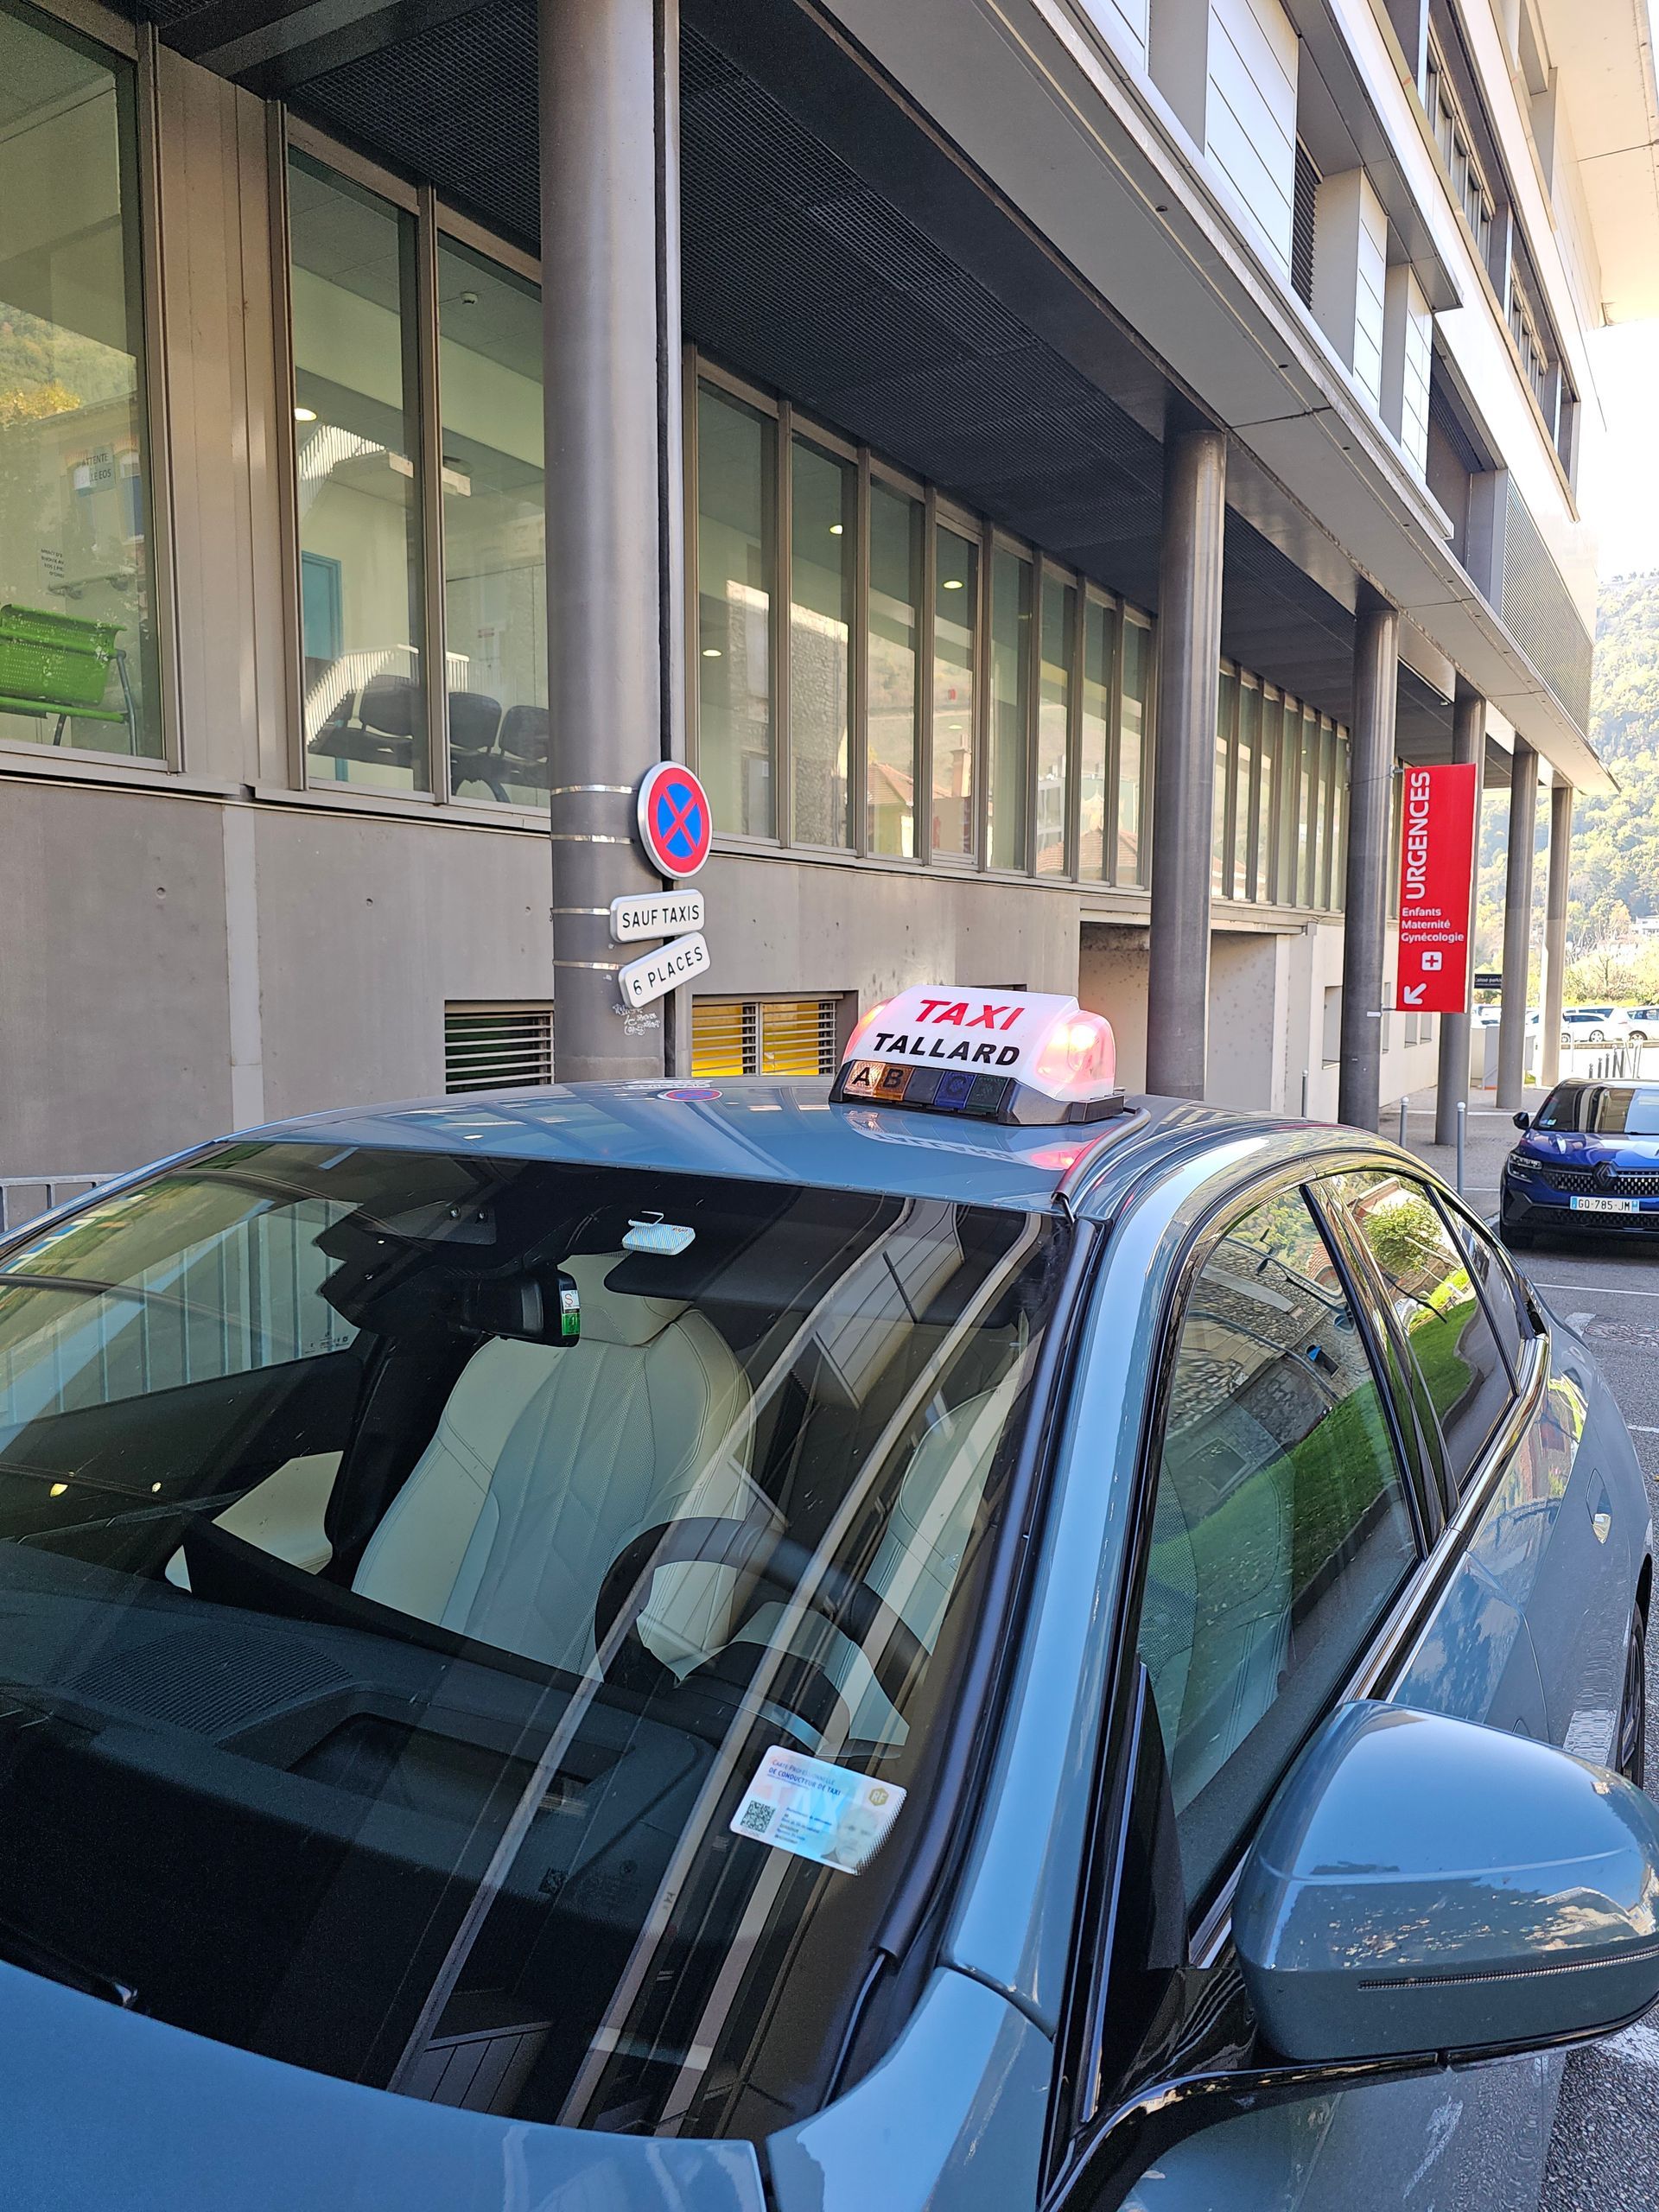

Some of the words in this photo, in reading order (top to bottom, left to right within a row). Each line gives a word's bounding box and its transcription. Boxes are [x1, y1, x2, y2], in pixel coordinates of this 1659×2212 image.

[82, 453, 109, 467] ATTENTE
[99, 468, 111, 480] EOS
[1406, 772, 1431, 899] URGENCES
[622, 909, 658, 929] SAUF
[662, 905, 700, 925] TAXIS
[1402, 906, 1442, 917] Enfants
[1401, 919, 1451, 930] Maternité
[1401, 931, 1465, 944] Gynécologie
[632, 980, 643, 996] 6
[647, 946, 703, 988] PLACES
[915, 999, 1026, 1031] TAXI
[873, 1033, 1020, 1066] TALLARD
[851, 1066, 871, 1086] A
[882, 1068, 904, 1088] B
[768, 1766, 778, 1776] DE
[778, 1770, 817, 1788] CONDUCTEUR
[817, 1782, 826, 1791] DE
[826, 1786, 842, 1796] TAXI
